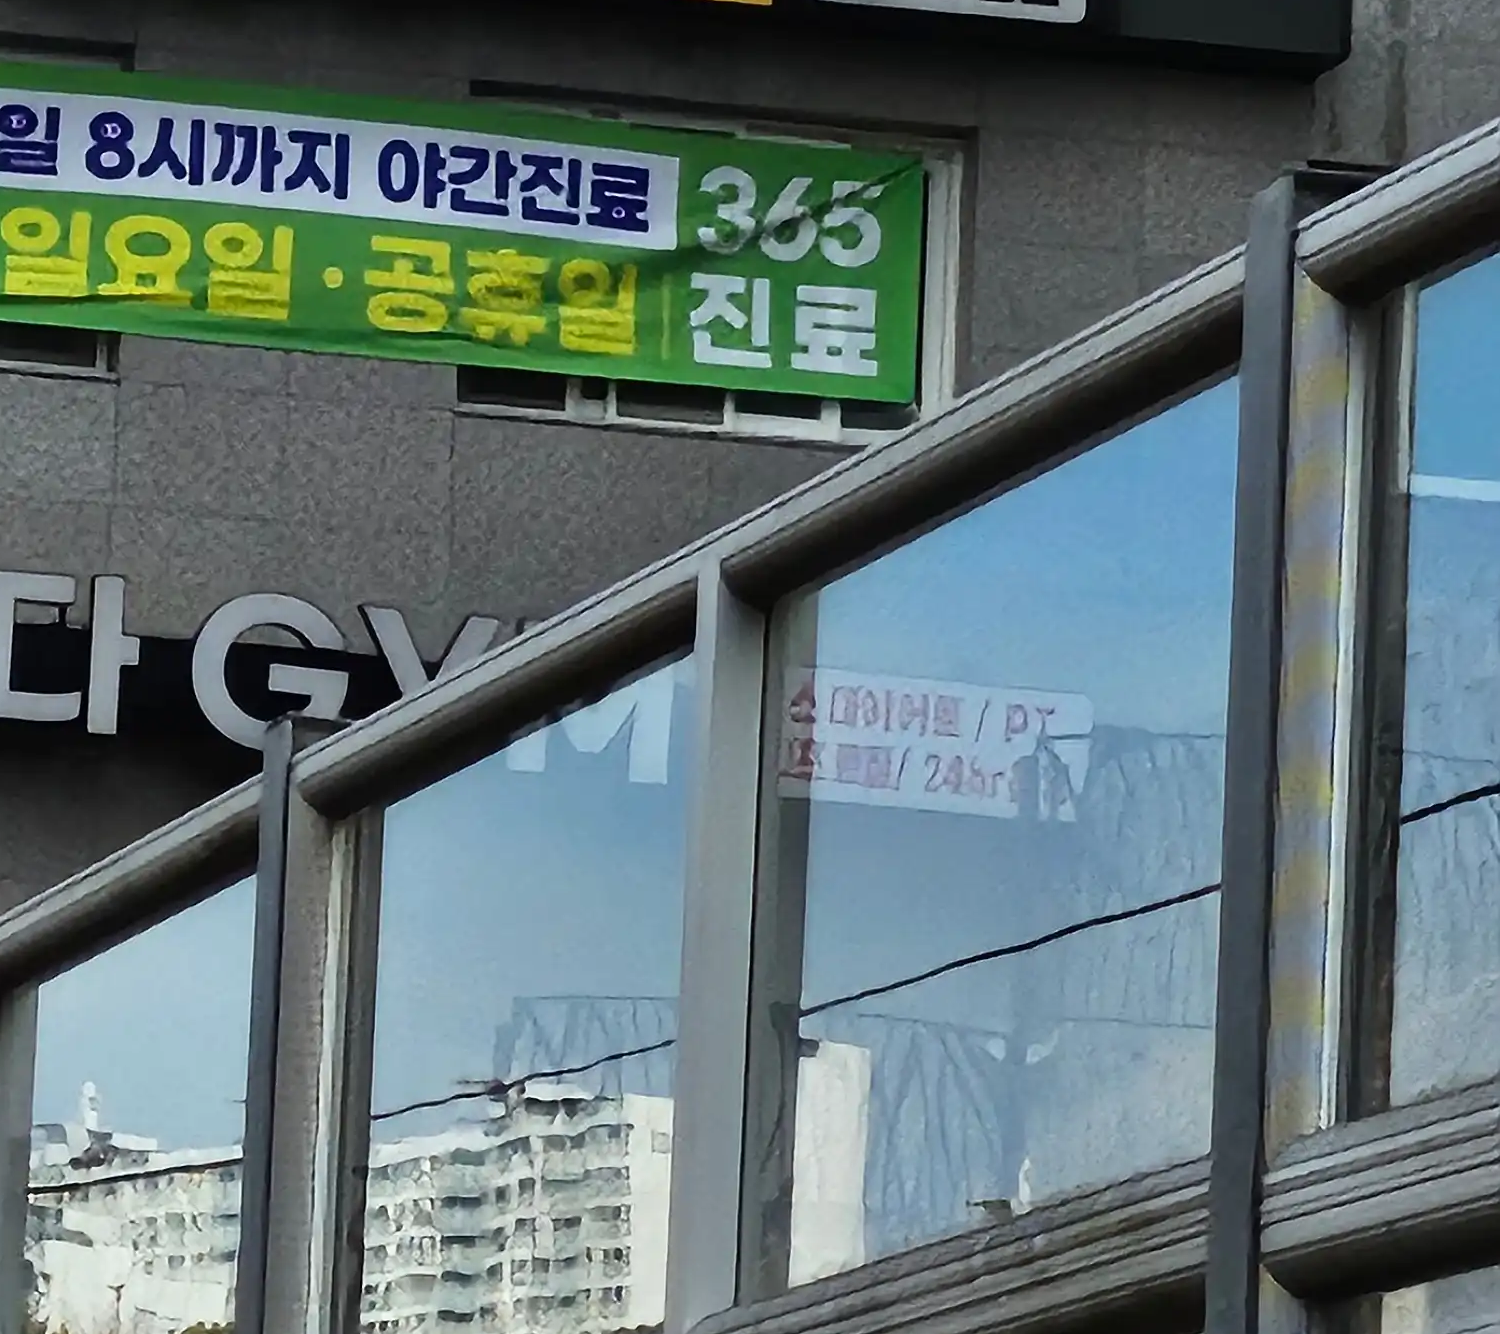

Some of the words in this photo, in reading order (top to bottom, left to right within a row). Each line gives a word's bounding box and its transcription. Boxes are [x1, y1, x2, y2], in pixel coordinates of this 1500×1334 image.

[85, 113, 350, 201] 8시까지
[377, 138, 650, 234] 야간진료
[696, 165, 884, 269] 365
[690, 273, 879, 378] 진료
